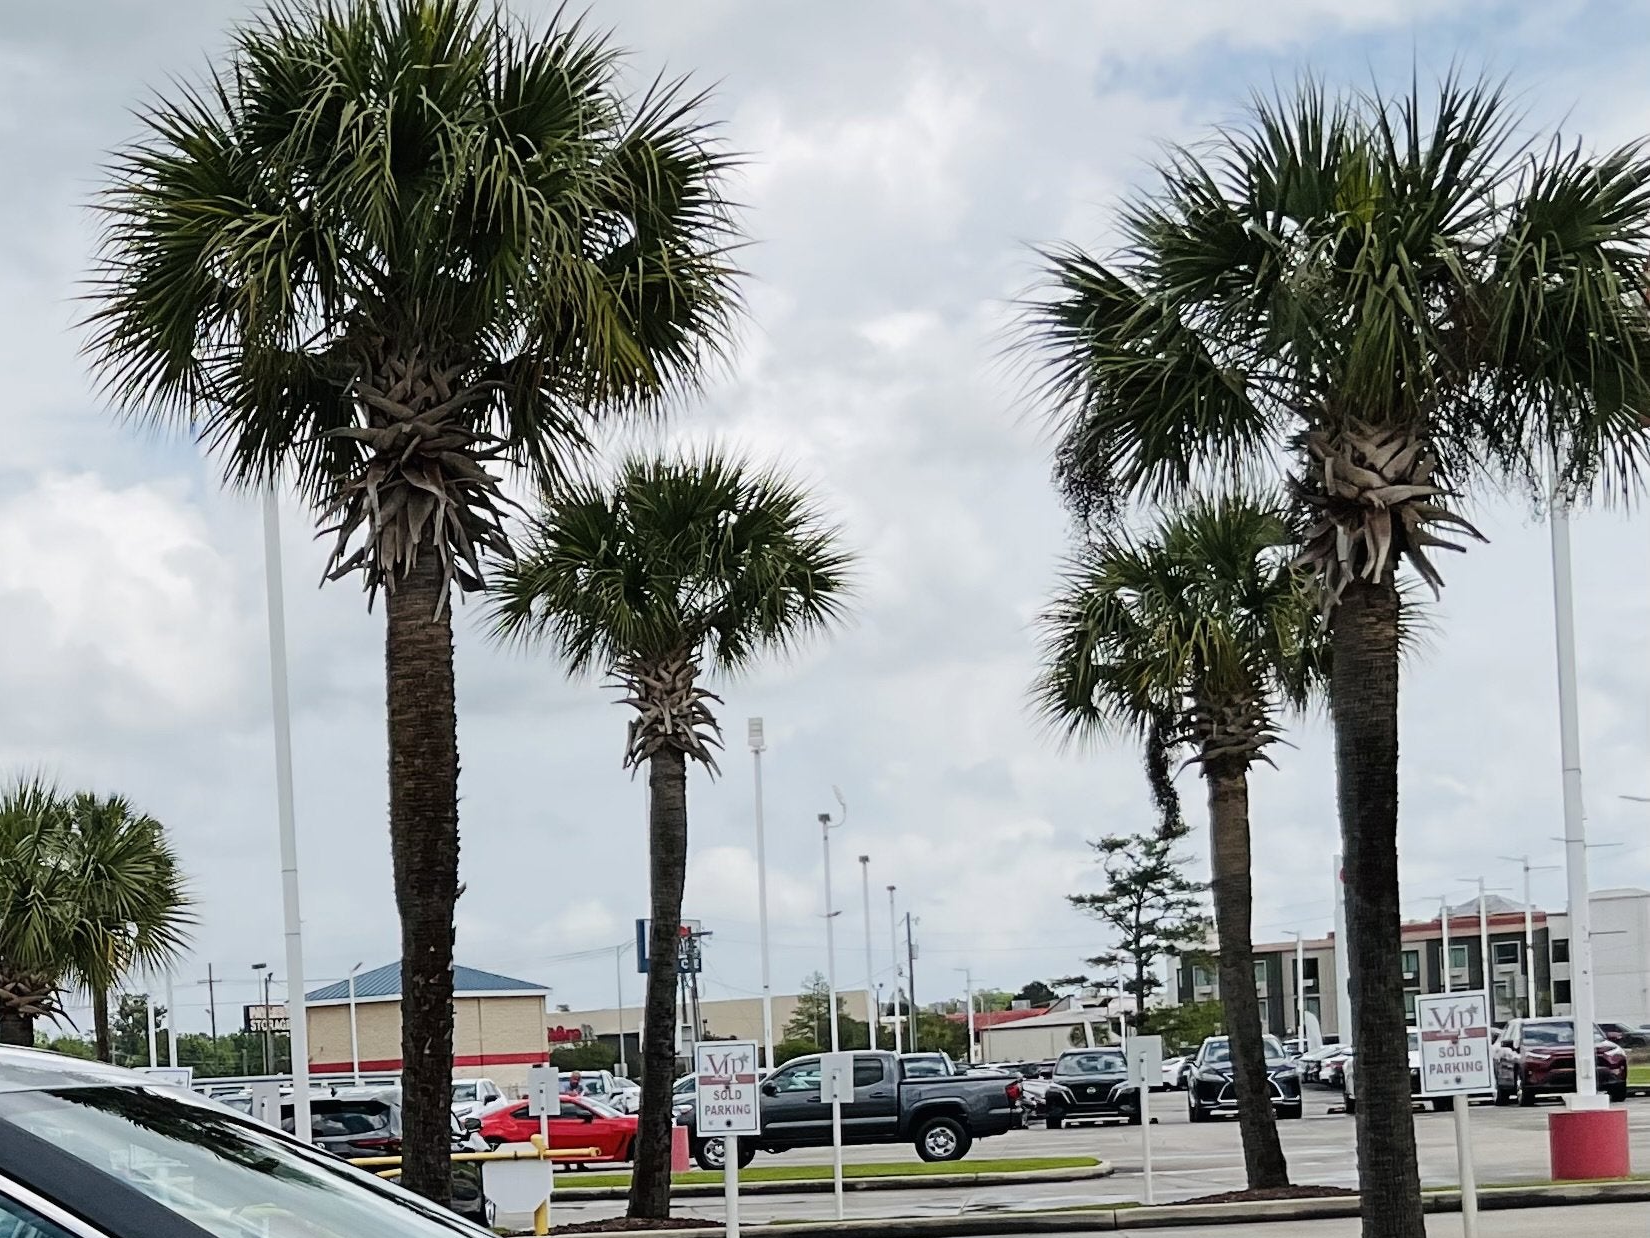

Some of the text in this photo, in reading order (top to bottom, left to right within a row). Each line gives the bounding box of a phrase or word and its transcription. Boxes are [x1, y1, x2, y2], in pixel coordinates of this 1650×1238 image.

[1438, 1045, 1472, 1058] SOLD
[1430, 1060, 1484, 1075] PARKING
[713, 1089, 742, 1101] SOLD
[704, 1103, 752, 1116] PARKING
